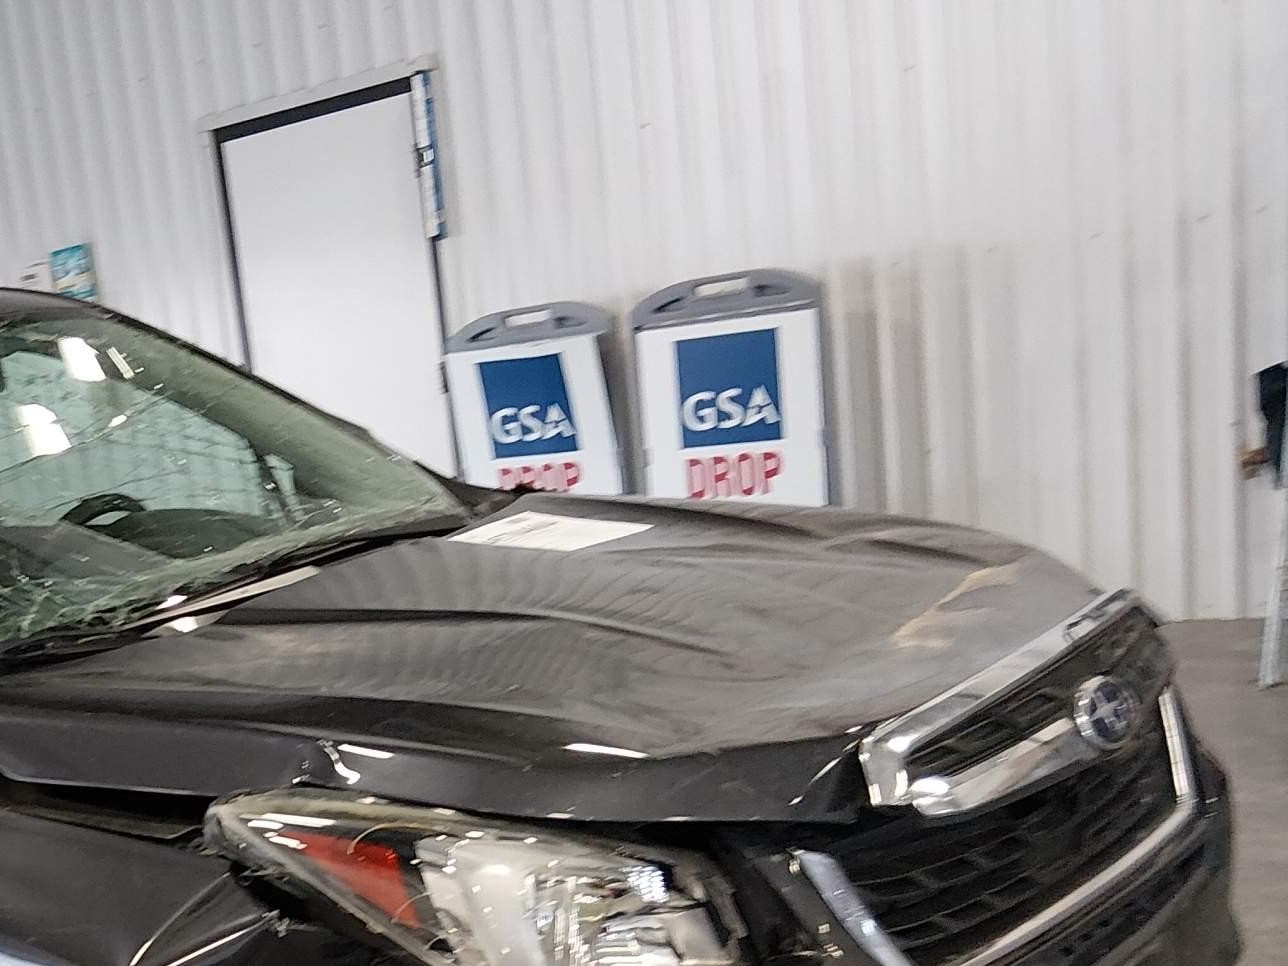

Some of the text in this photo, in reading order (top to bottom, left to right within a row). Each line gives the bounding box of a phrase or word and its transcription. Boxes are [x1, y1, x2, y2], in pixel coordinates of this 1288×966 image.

[491, 402, 577, 445] GSA
[682, 383, 782, 432] GSA
[686, 451, 782, 499] DROP
